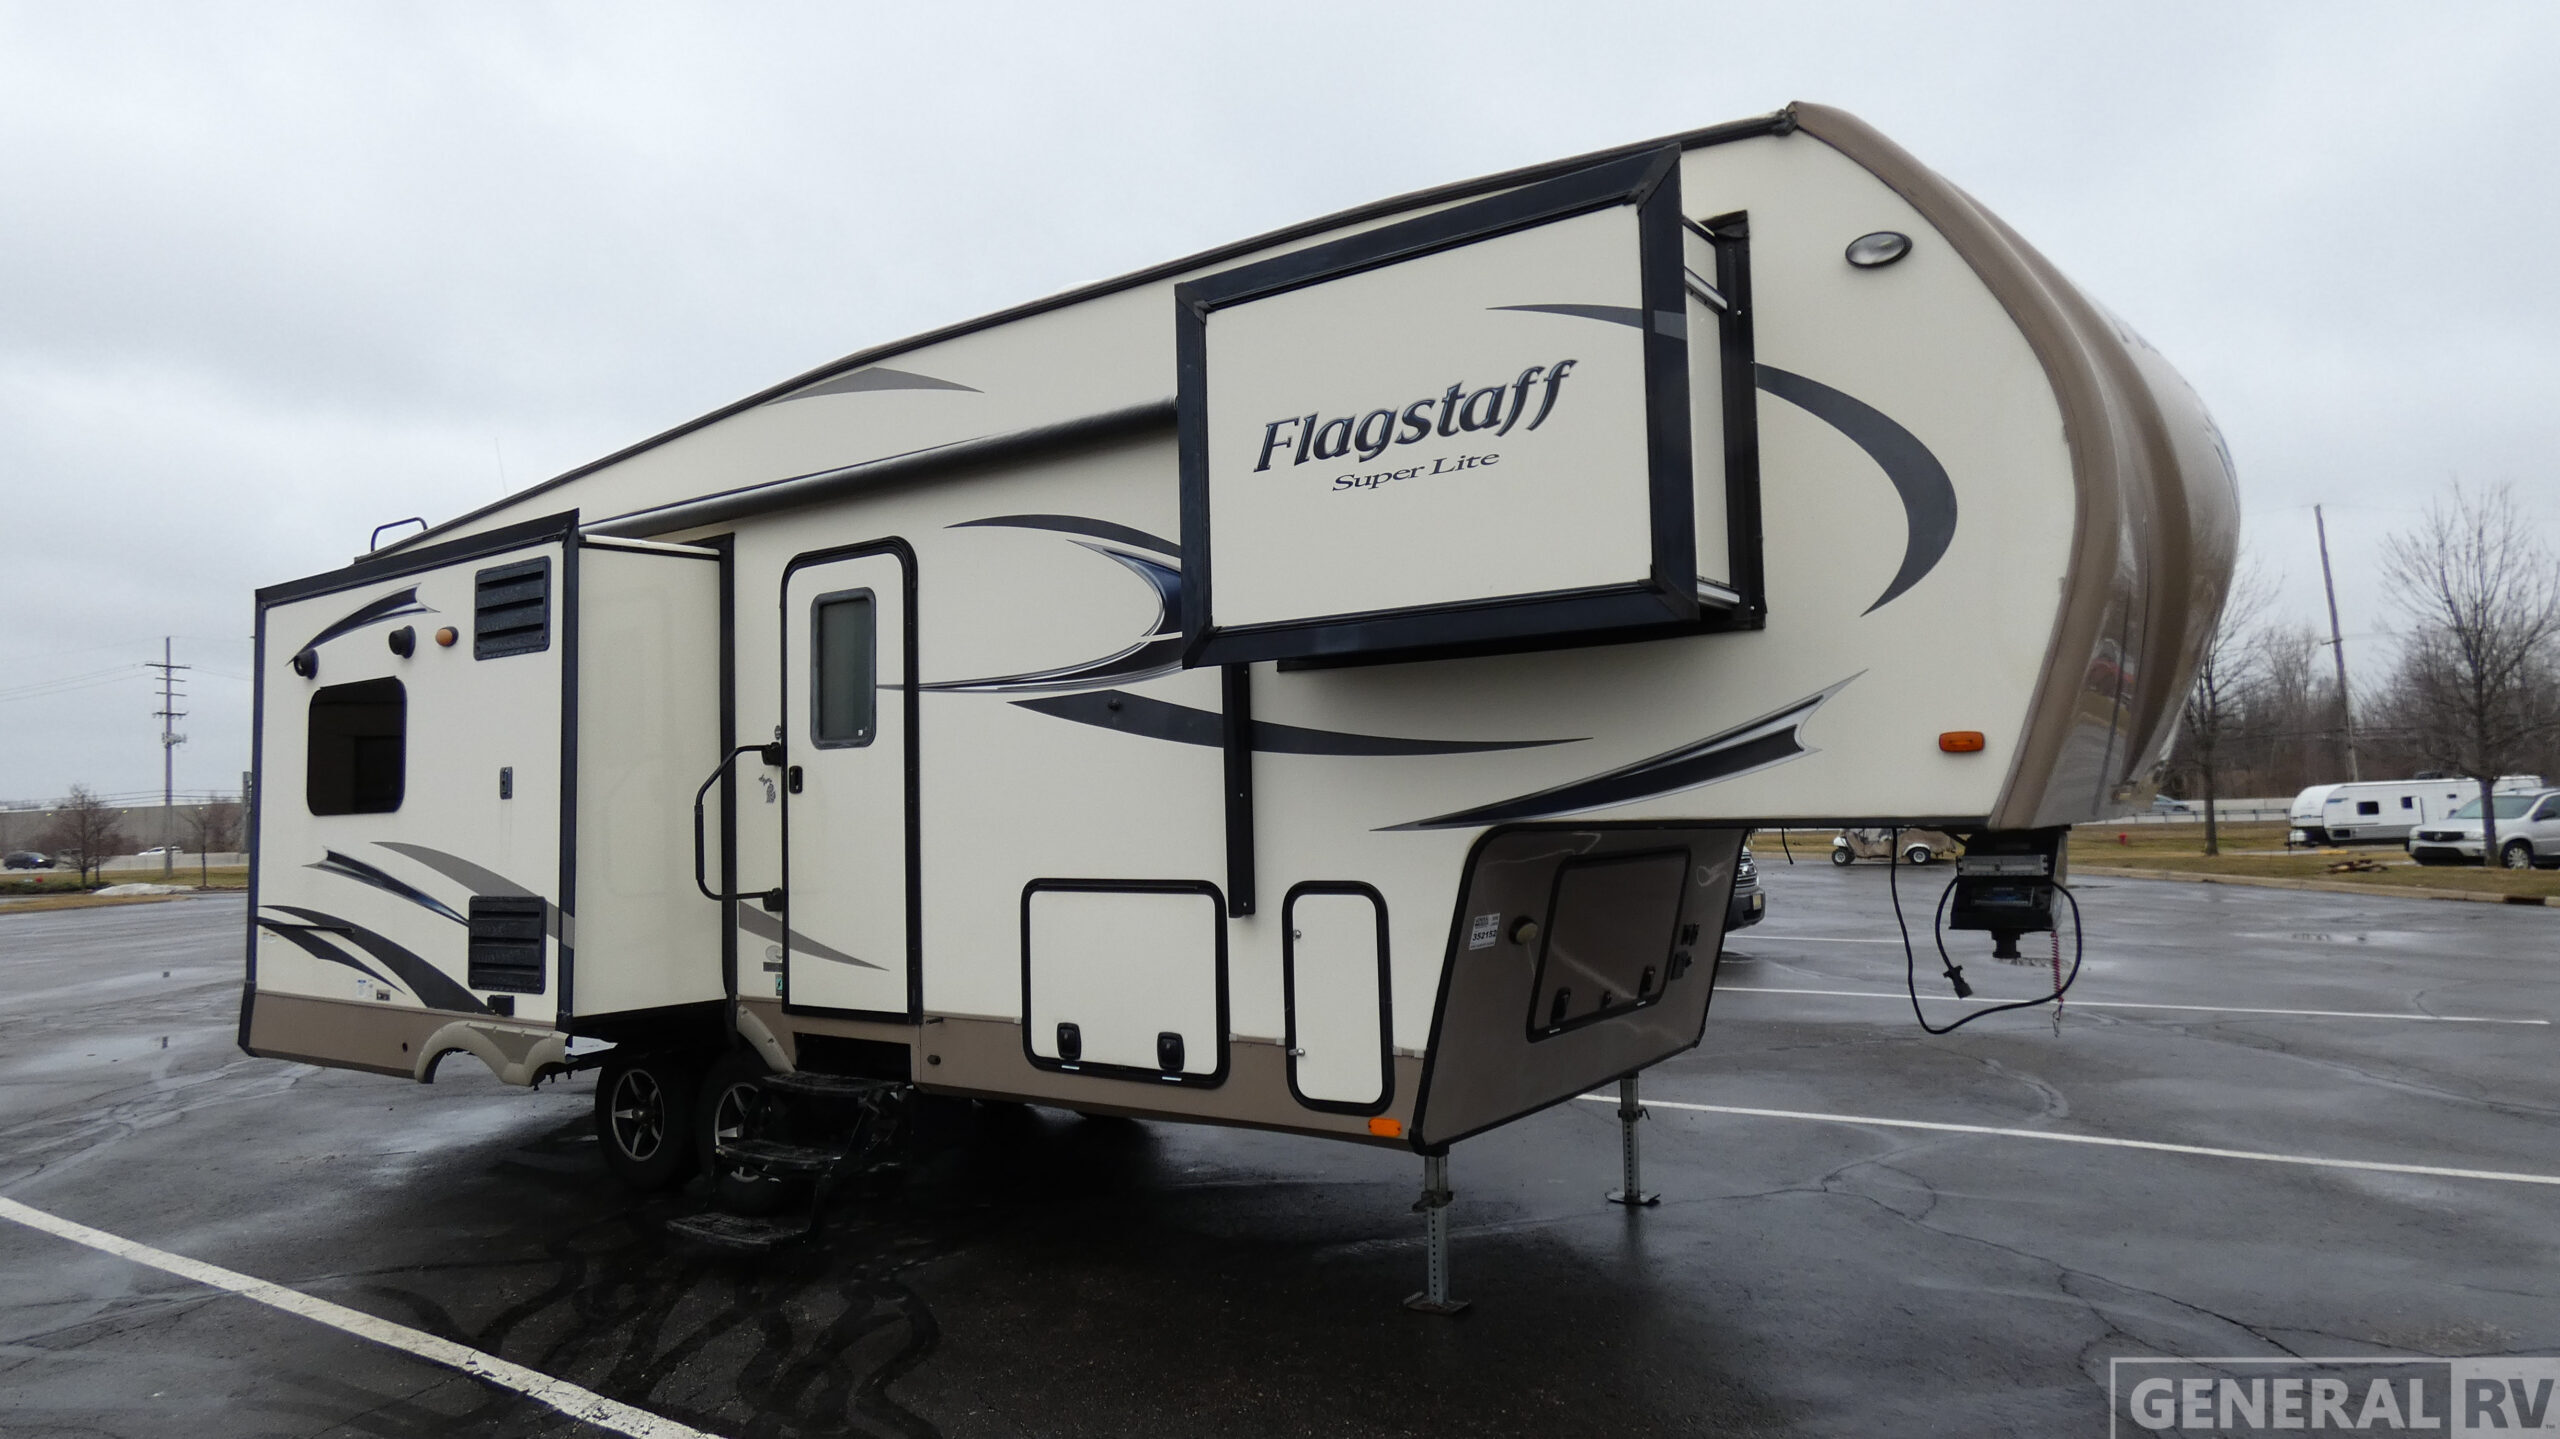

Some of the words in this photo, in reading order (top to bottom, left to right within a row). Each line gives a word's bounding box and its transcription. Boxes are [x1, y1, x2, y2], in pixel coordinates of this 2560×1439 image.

[1253, 359, 1578, 473] Flagstaff
[1332, 464, 1428, 491] Super
[1429, 452, 1500, 476] Lite
